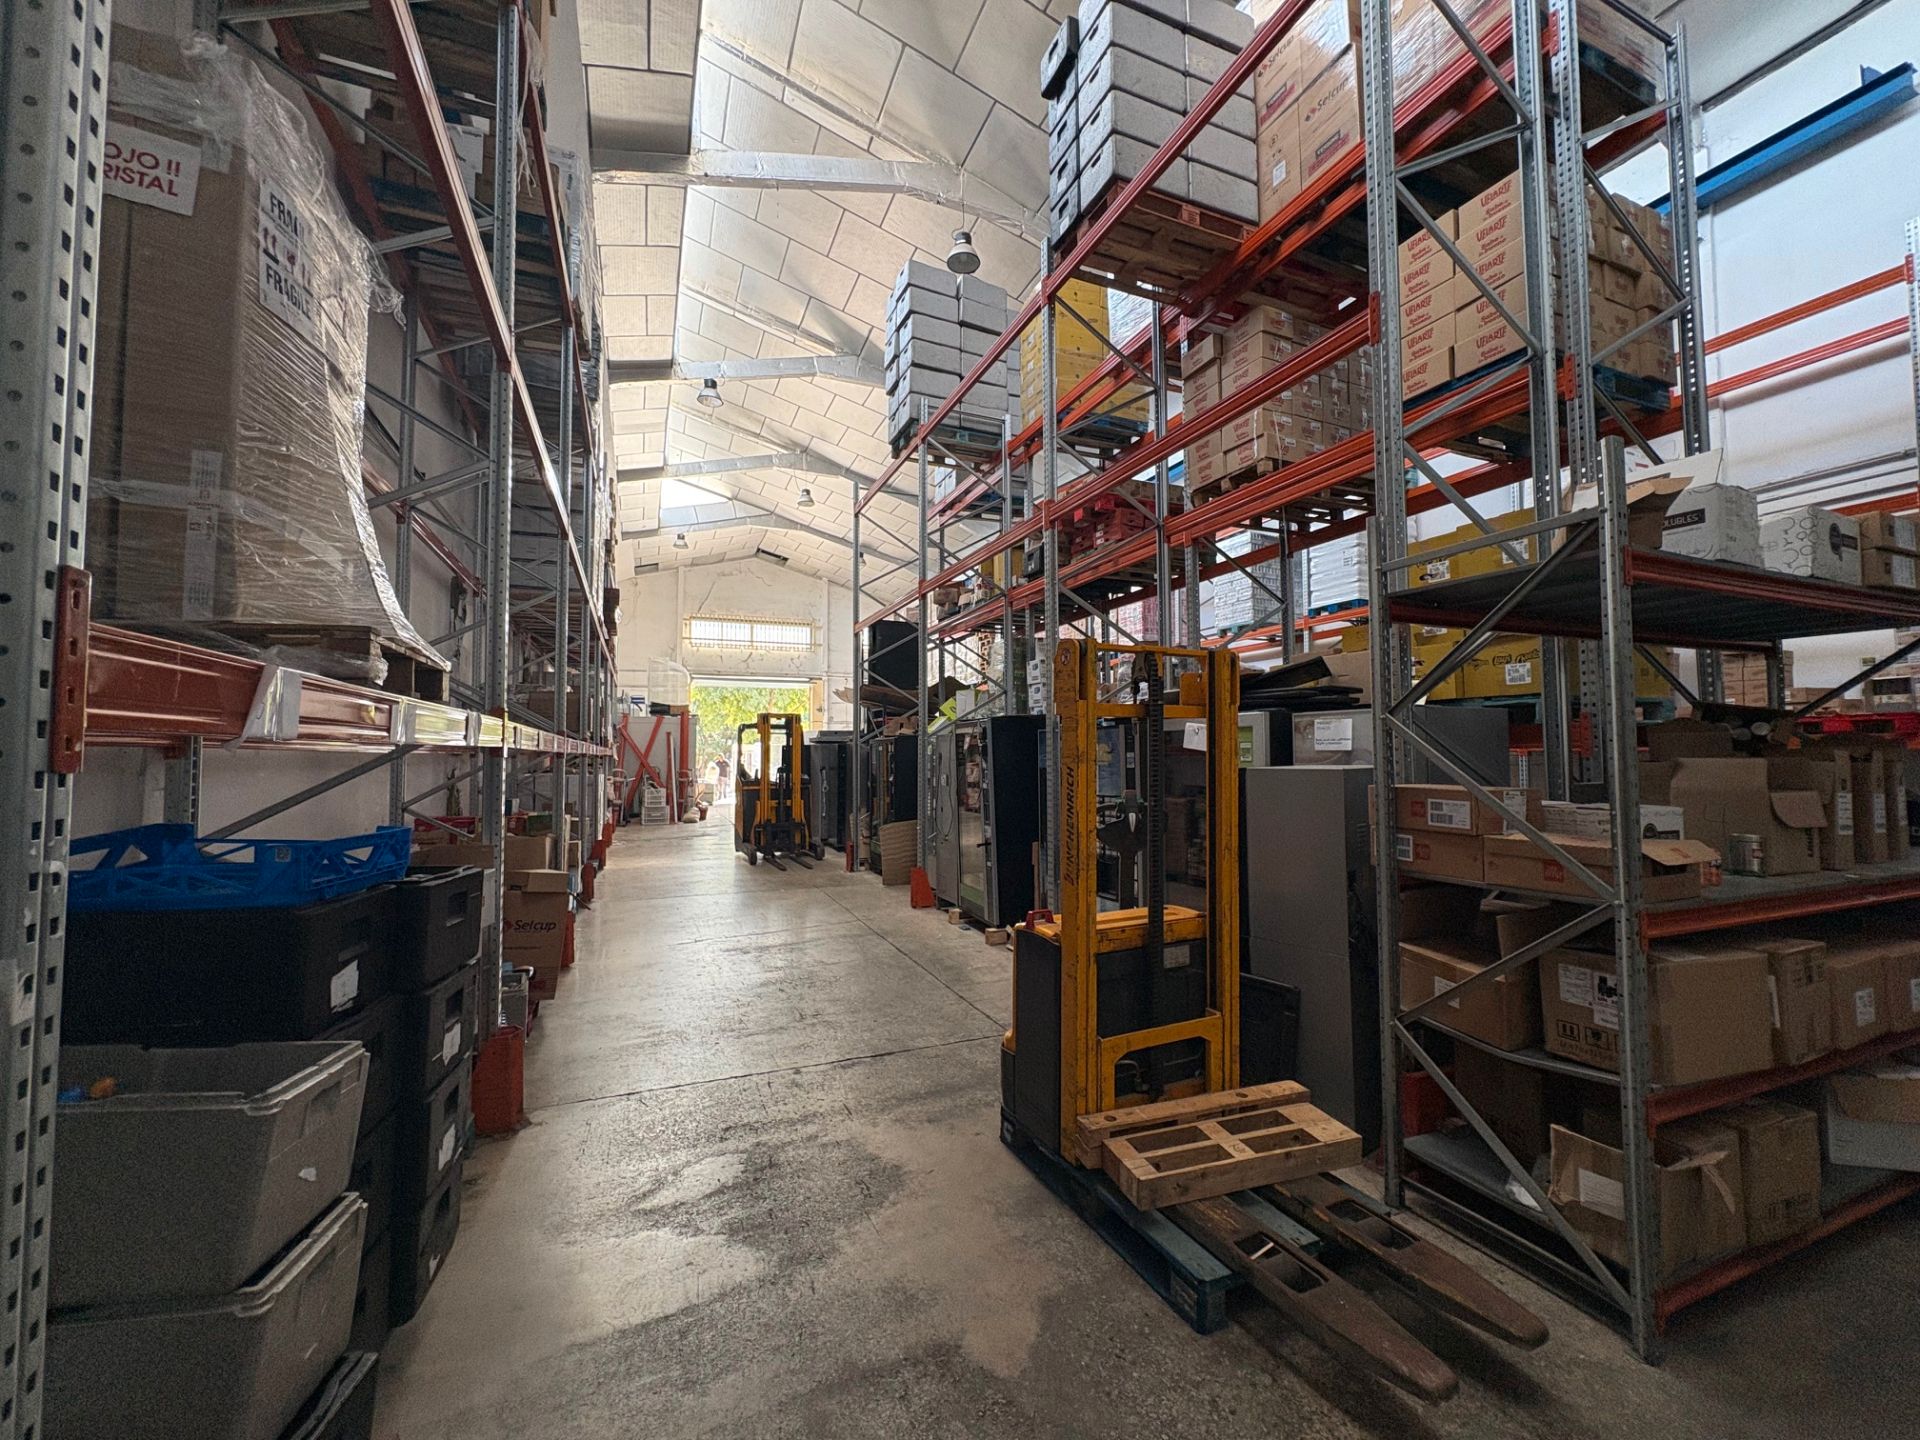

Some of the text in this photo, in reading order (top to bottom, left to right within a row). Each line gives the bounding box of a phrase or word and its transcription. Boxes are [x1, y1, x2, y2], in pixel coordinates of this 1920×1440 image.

[104, 142, 160, 170] OJO
[103, 162, 178, 197] RISTAL
[265, 263, 312, 320] FRAGILE
[1663, 512, 1699, 528] OLUBLES
[1064, 766, 1075, 886] JUNGHEINRICH
[513, 919, 557, 933] Selcup
